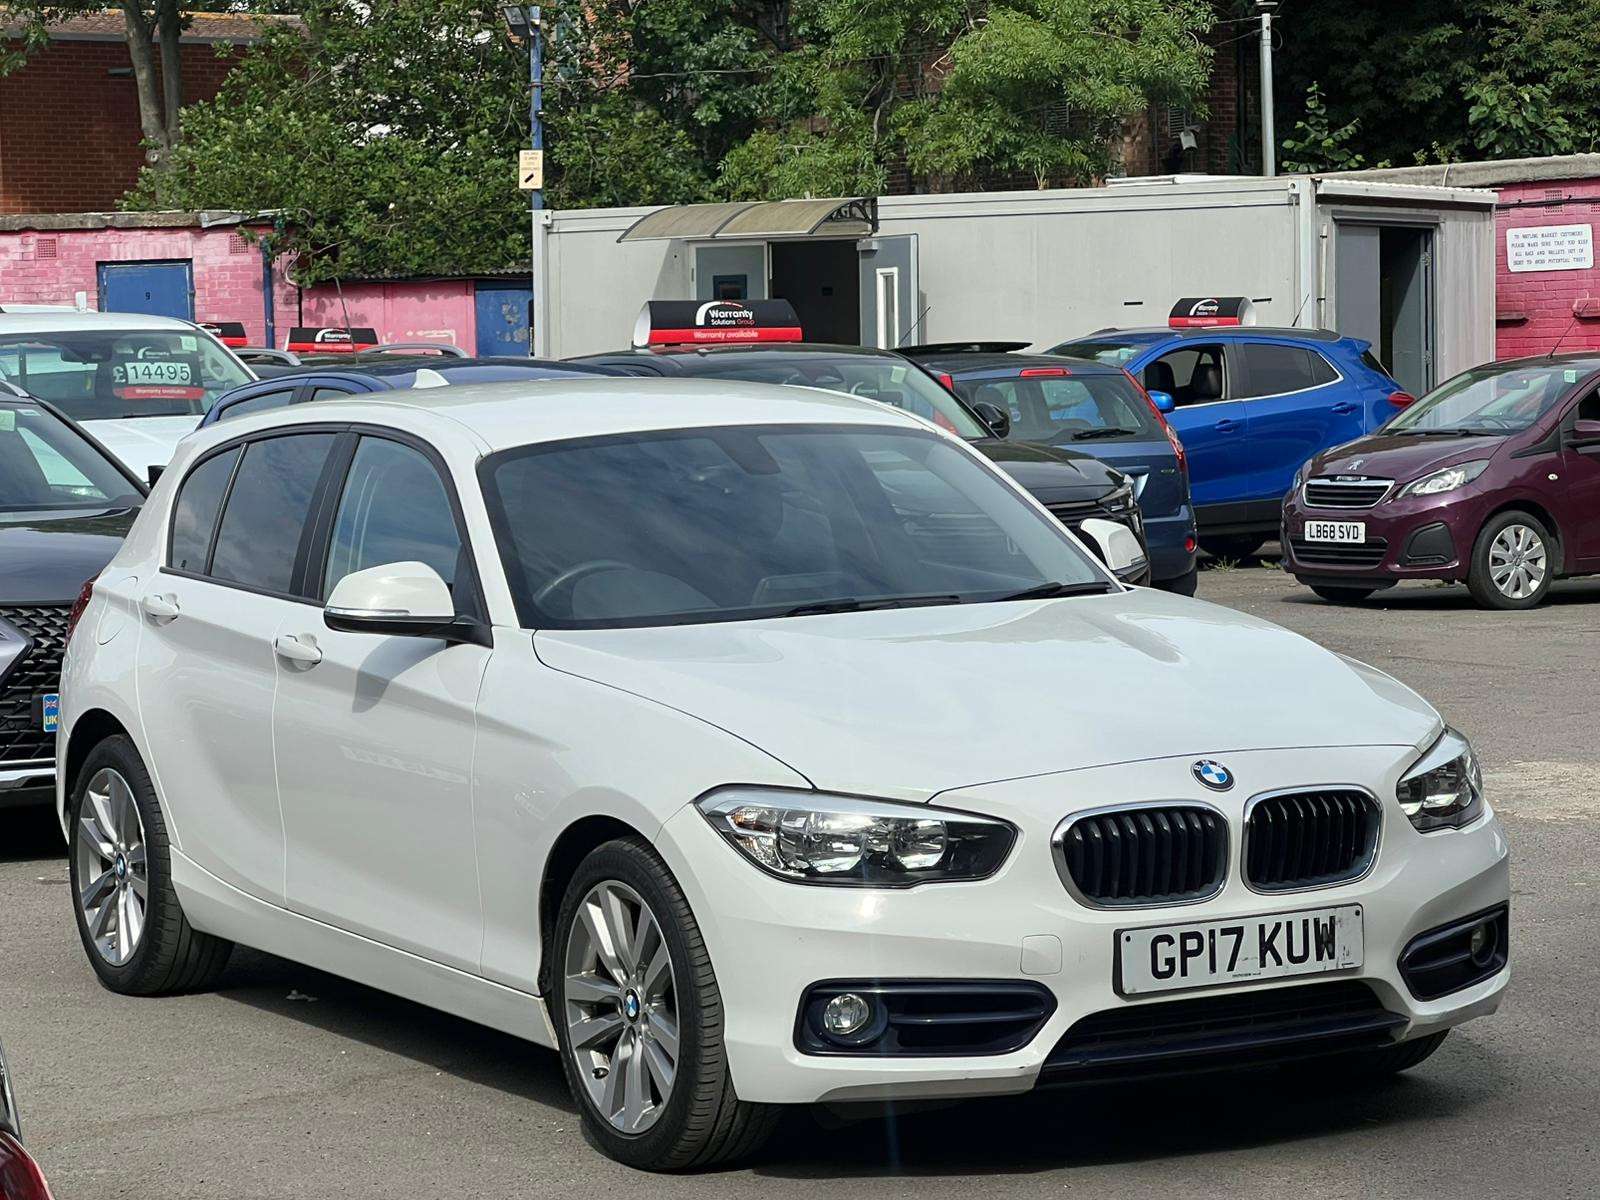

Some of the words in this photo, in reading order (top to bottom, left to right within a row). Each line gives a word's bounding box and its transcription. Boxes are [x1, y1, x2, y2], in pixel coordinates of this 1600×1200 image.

[145, 291, 151, 300] 9
[708, 309, 753, 320] Warranty
[693, 330, 726, 340] Warranty
[726, 330, 759, 339] available
[1309, 524, 1336, 539] LB68
[1338, 524, 1359, 540] SVD
[1150, 925, 1245, 980] GP17
[1258, 915, 1337, 969] KUW
